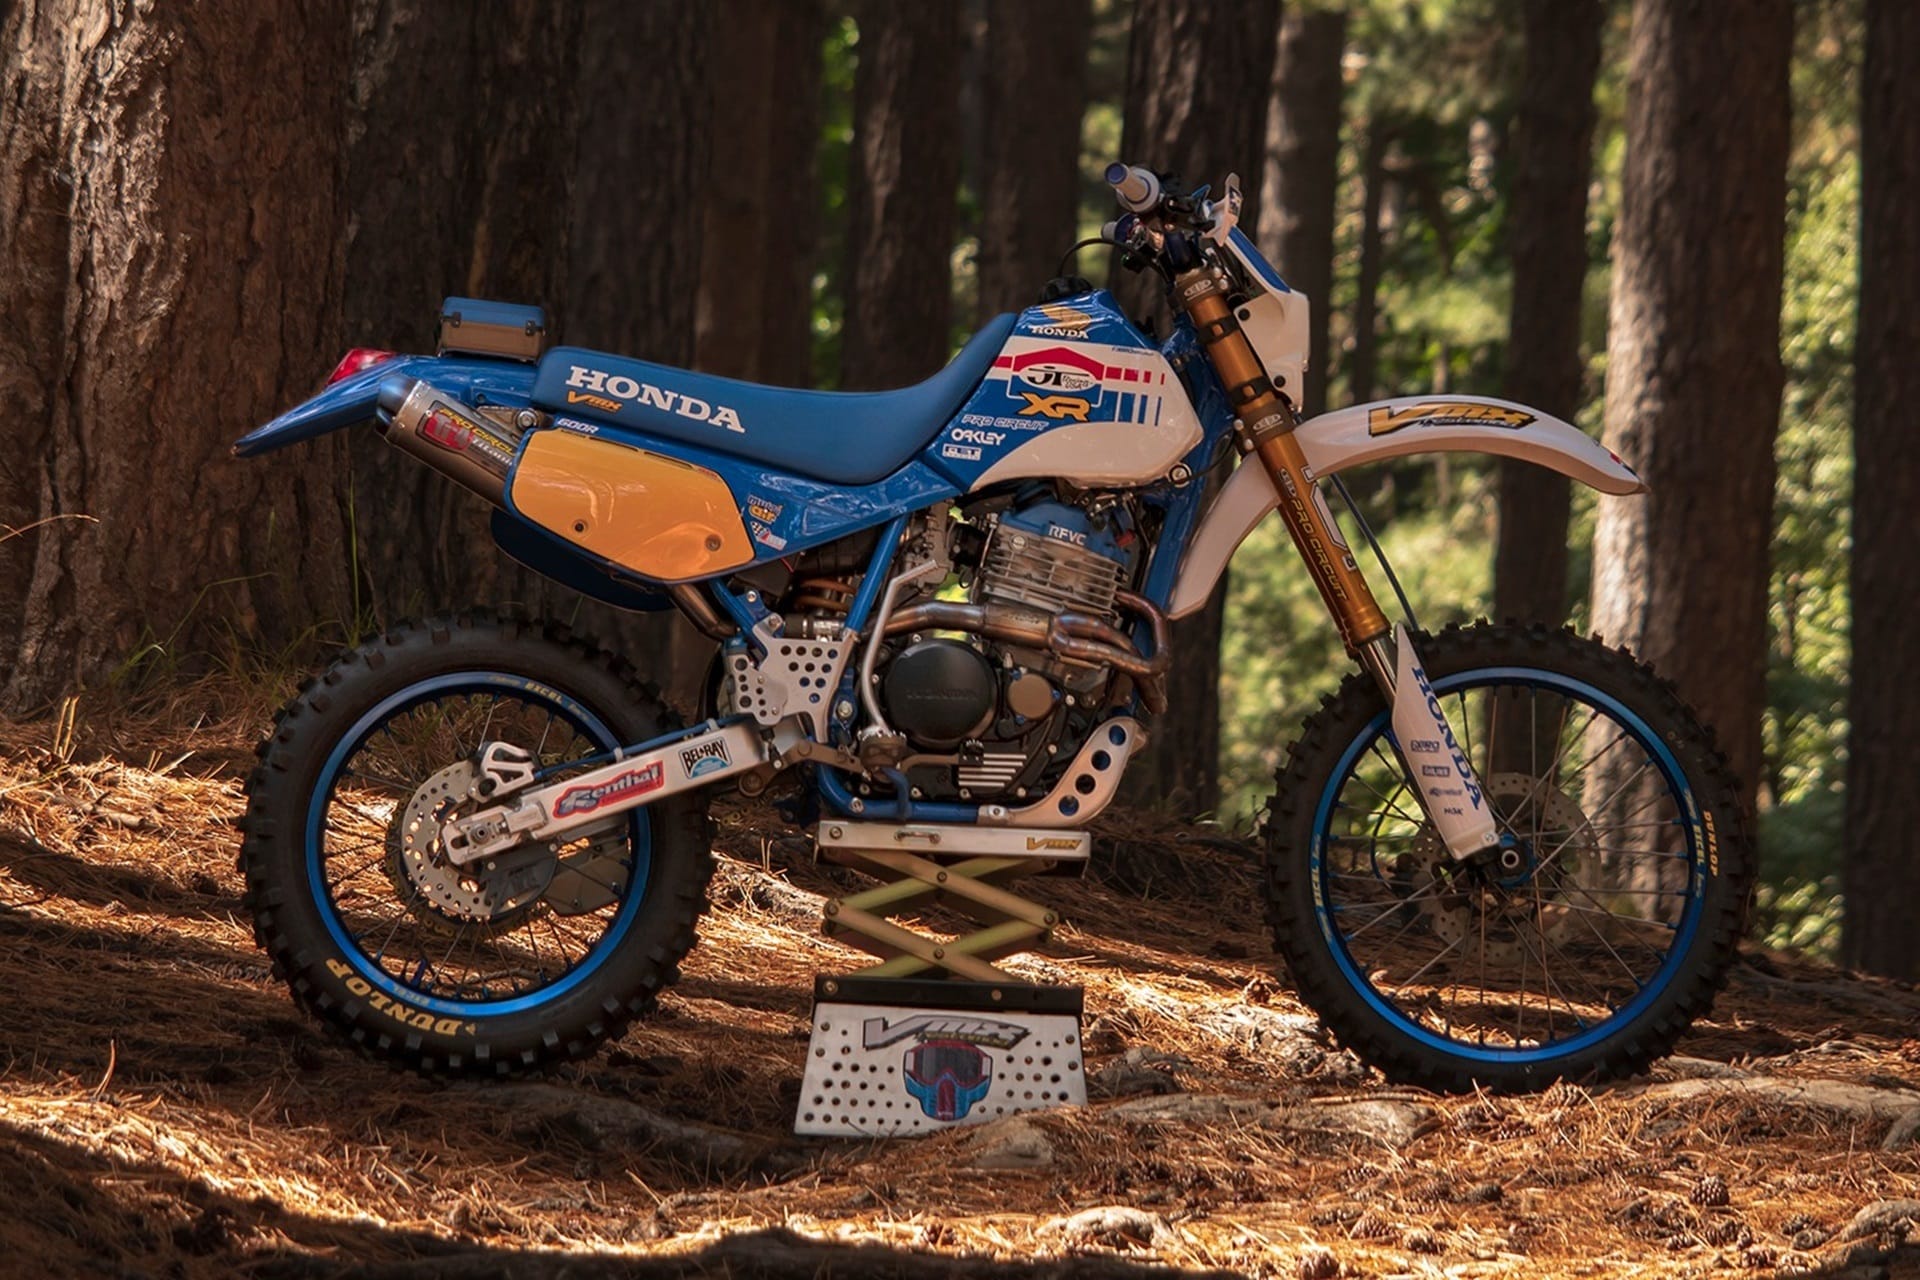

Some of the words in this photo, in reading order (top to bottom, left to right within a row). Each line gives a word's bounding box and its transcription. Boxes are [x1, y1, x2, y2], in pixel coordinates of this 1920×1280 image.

[1029, 325, 1089, 339] HONDA
[566, 366, 746, 434] HONDA
[961, 414, 994, 427] PRO
[994, 417, 1049, 430] CIRCUIT
[1017, 392, 1091, 421] XR
[439, 408, 472, 429] PRO
[472, 427, 516, 457] CIRCU
[951, 428, 1006, 445] OAKLEY
[1049, 525, 1087, 546] RFVC
[1291, 499, 1313, 535] PRO
[1310, 533, 1348, 600] CIRCUIT
[1411, 667, 1481, 810] HONDA
[1703, 810, 1719, 877] DUNLOP
[326, 958, 463, 1036] DUNLOP
